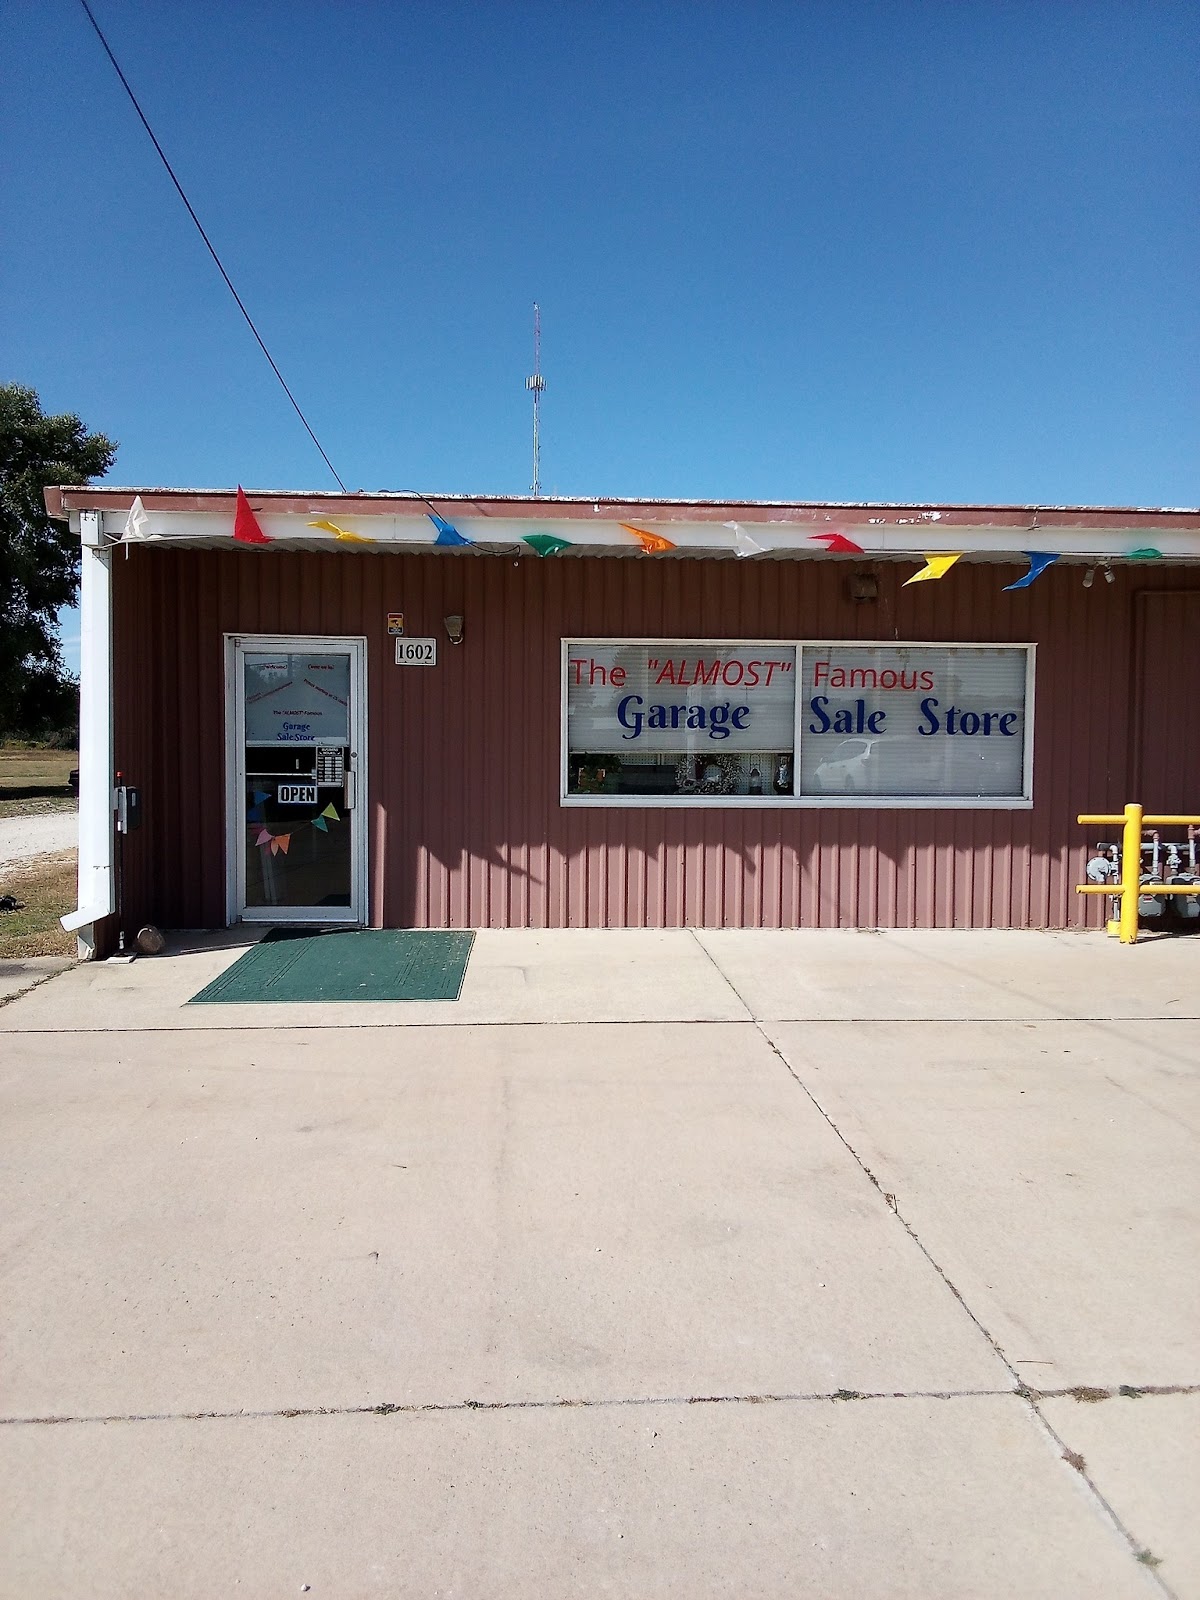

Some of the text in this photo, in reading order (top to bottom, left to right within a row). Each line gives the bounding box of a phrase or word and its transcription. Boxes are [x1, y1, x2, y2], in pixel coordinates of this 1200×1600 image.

[398, 644, 433, 660] 1602
[570, 658, 935, 691] The "ALMOST" Famous
[617, 694, 1019, 740] Garage Sale Store
[283, 721, 311, 732] Garage
[277, 732, 316, 742] Sale Store
[281, 786, 315, 802] OPEN
